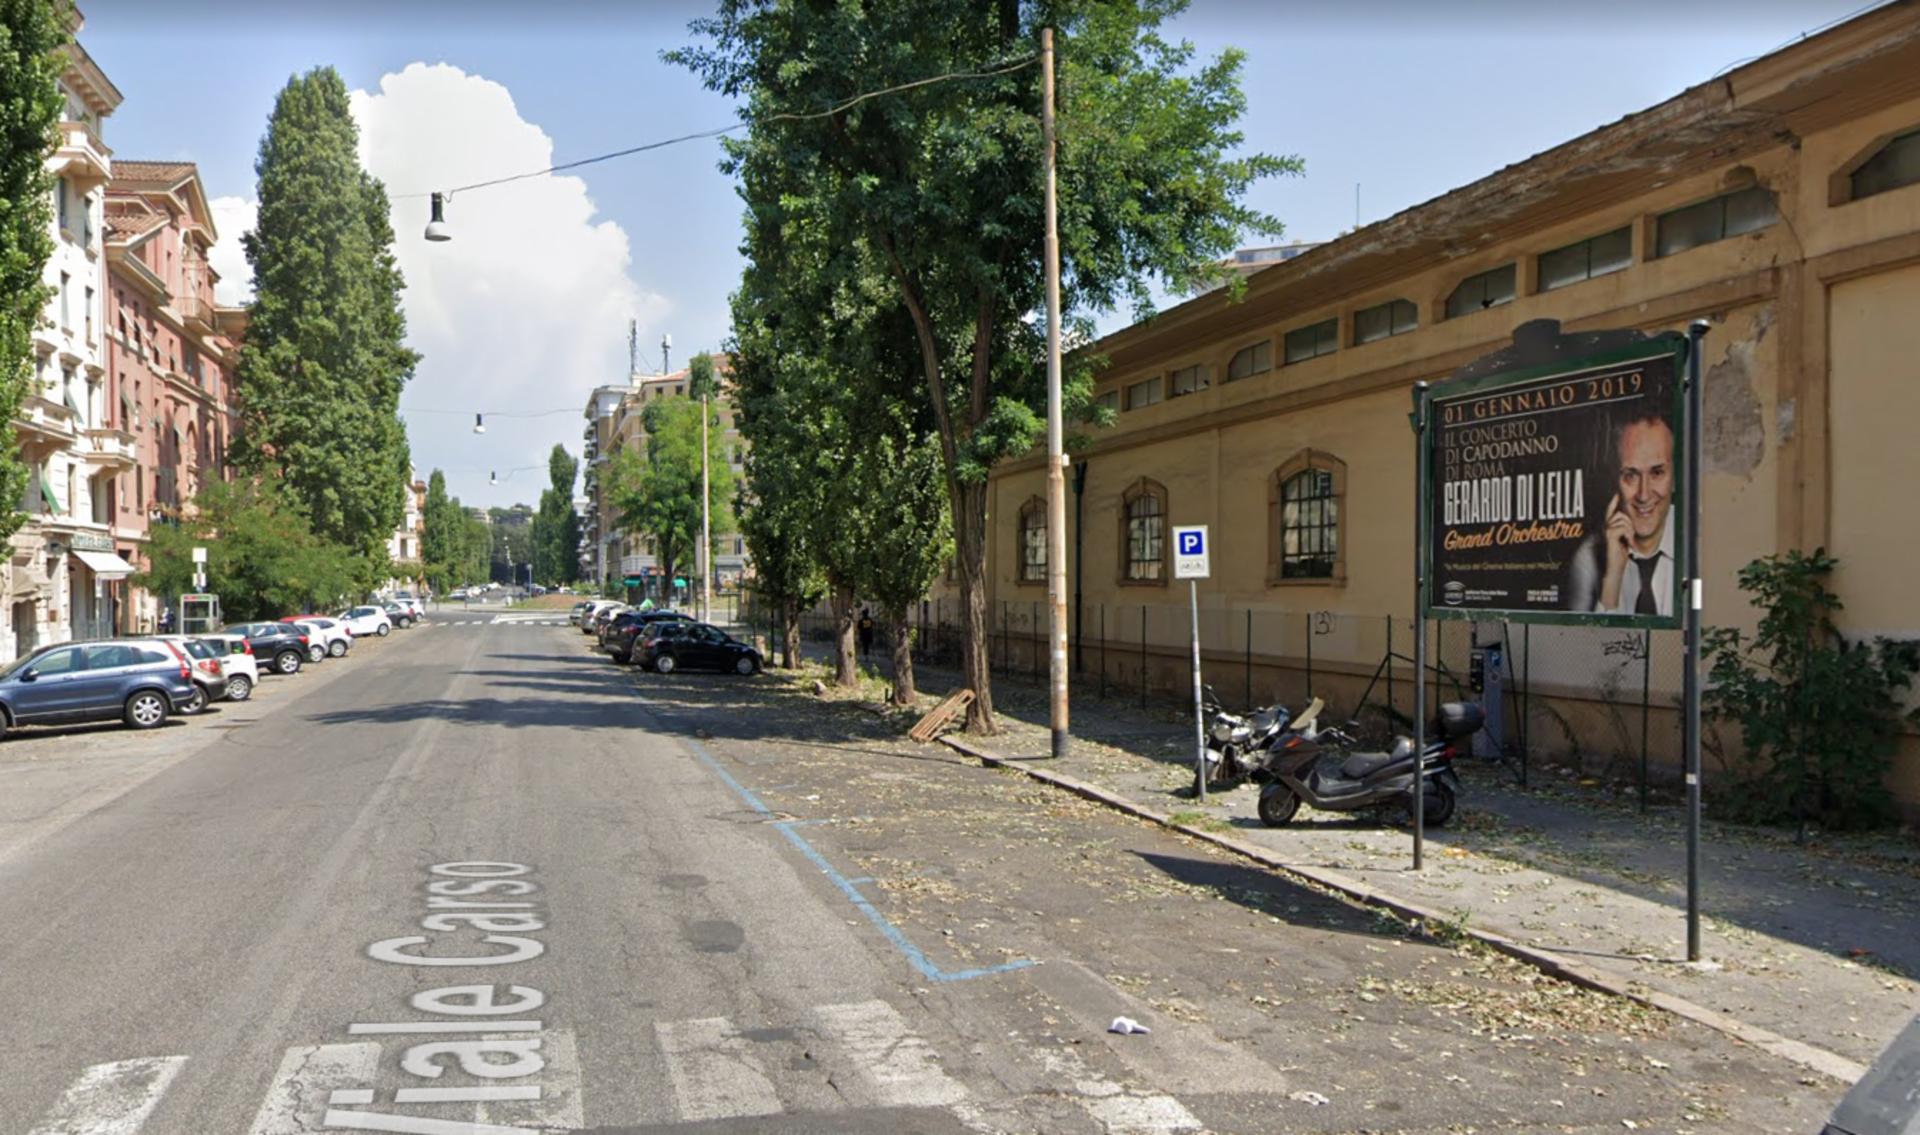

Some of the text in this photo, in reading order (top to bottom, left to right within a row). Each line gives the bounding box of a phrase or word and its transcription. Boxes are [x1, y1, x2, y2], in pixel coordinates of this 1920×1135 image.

[1444, 373, 1642, 424] 01 GENNAIO 2019
[1445, 419, 1538, 446] IL CONCERTO
[1445, 435, 1559, 465] DI CAPODANNO
[1445, 462, 1505, 480] DI ROMA
[1444, 469, 1585, 526] GERARDO DI LELLA
[1184, 535, 1198, 552] P
[1444, 519, 1584, 551] Grand Orchestra
